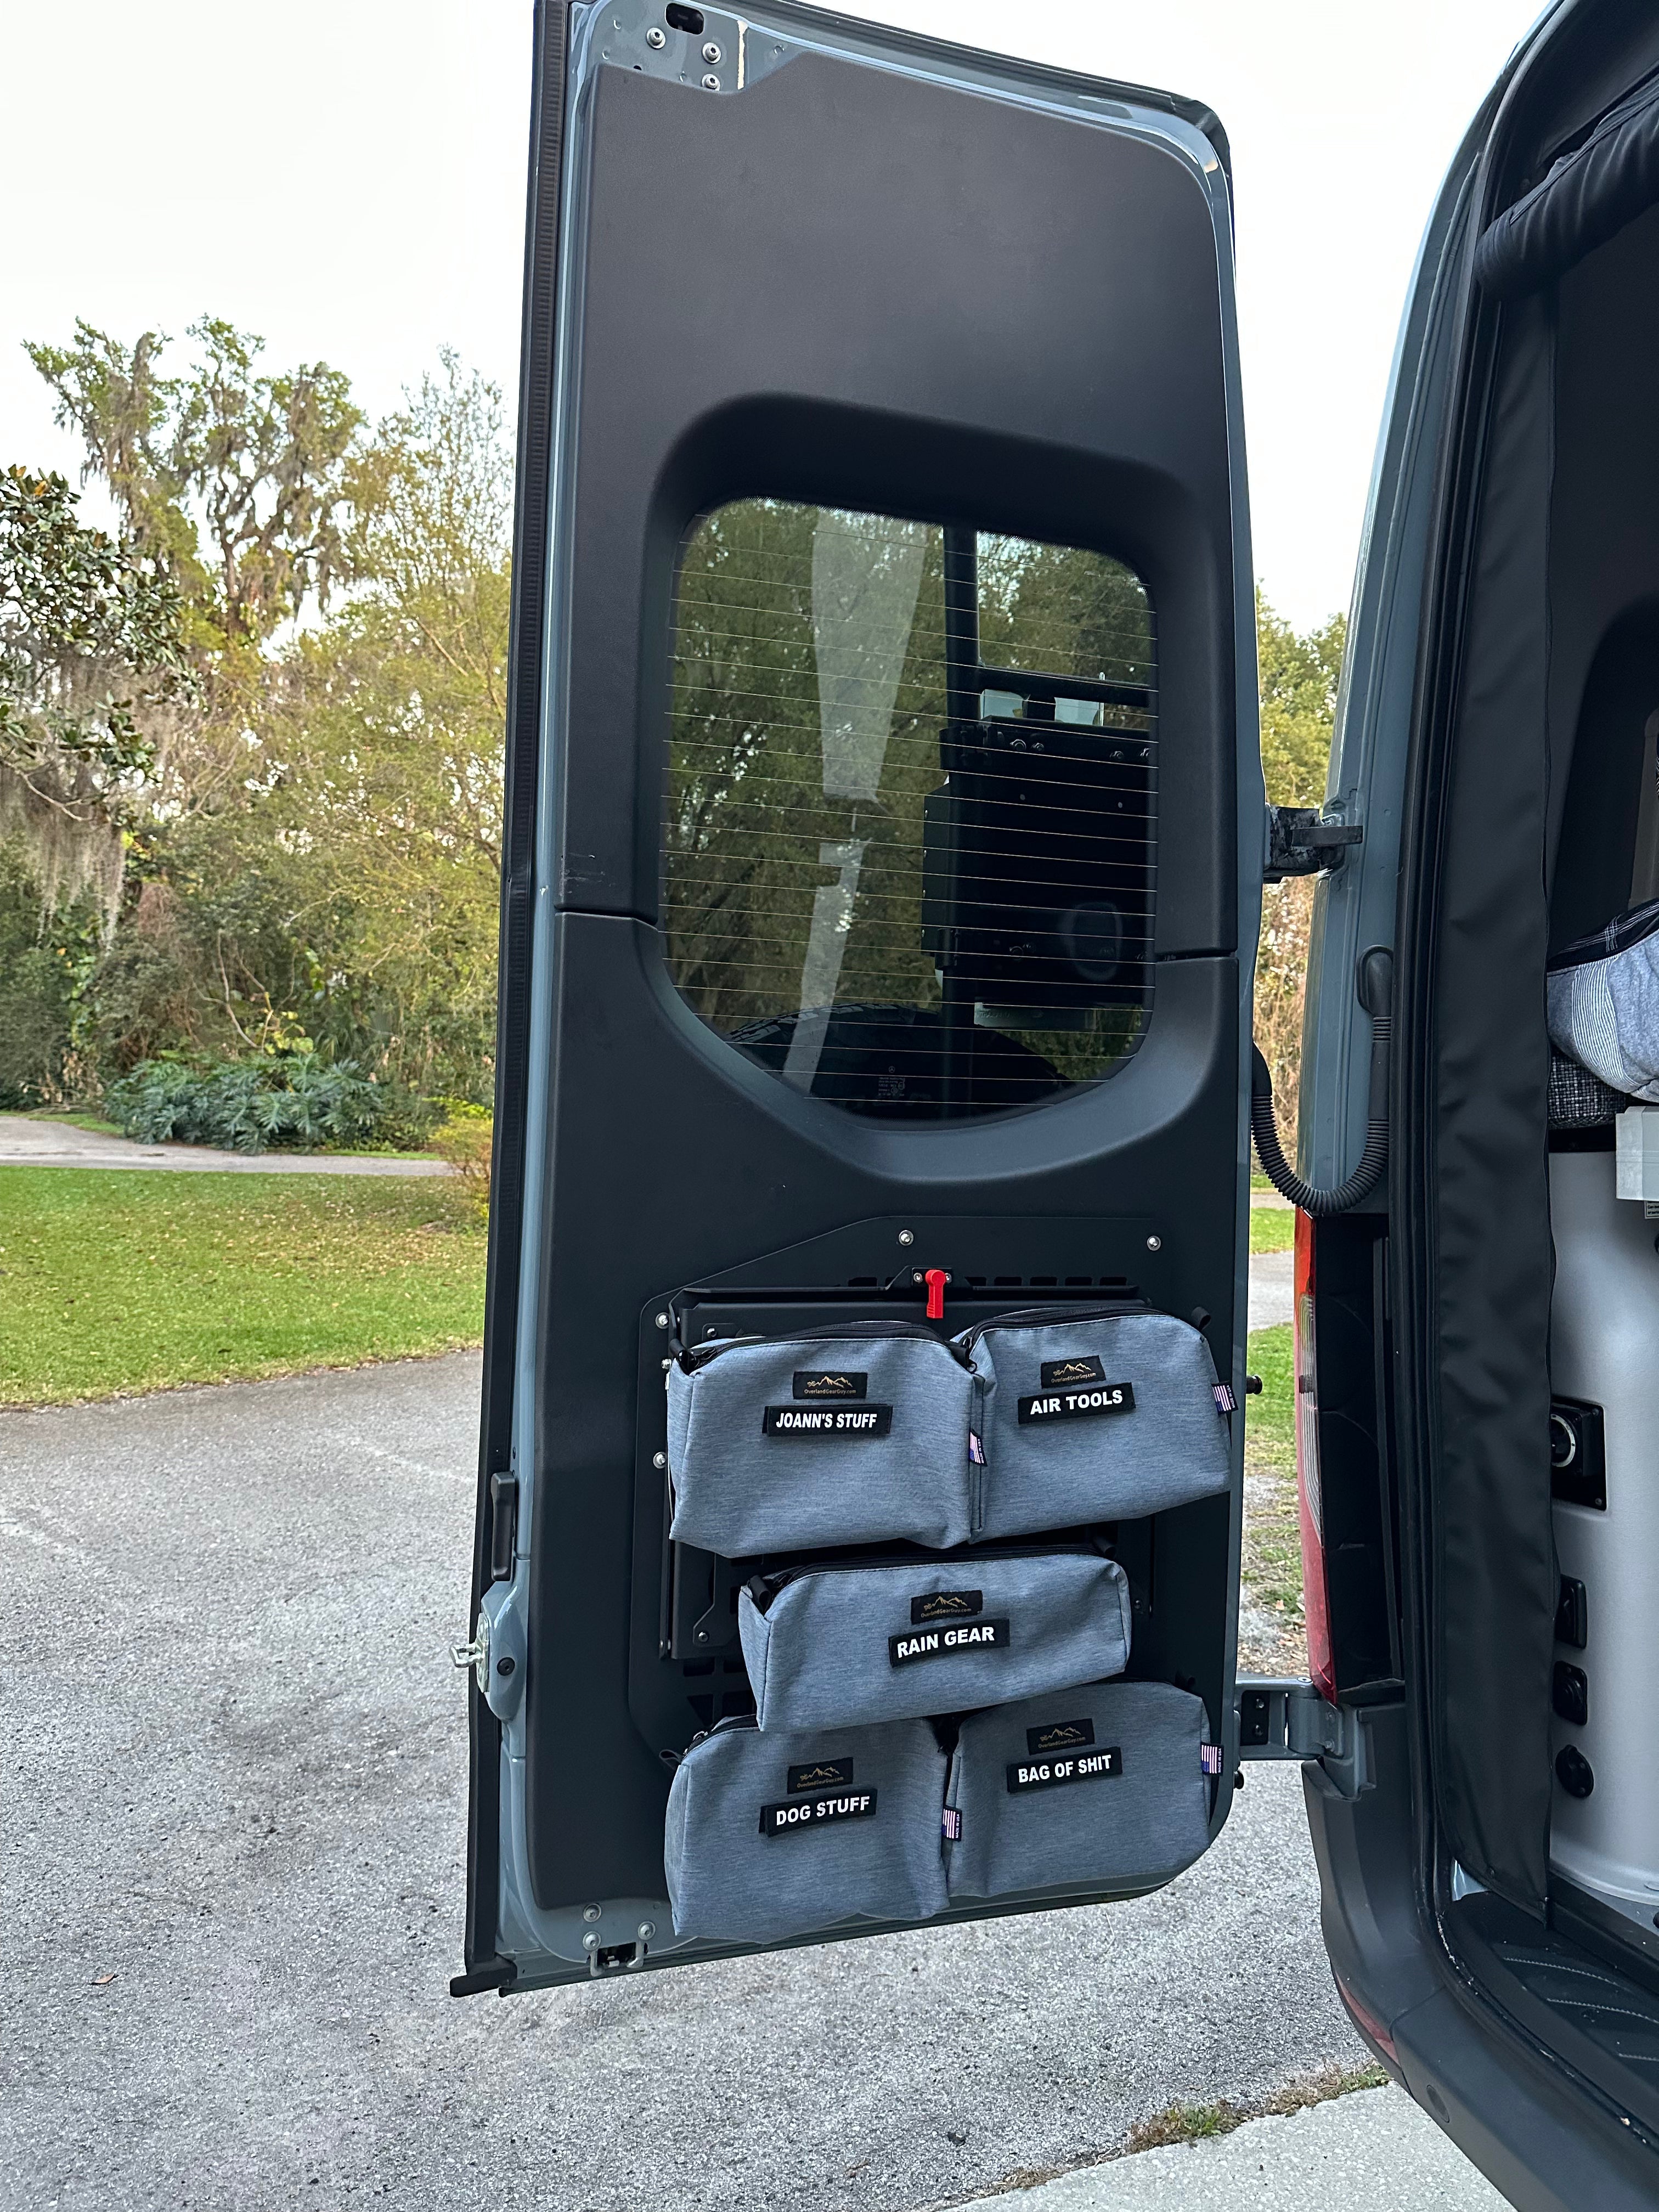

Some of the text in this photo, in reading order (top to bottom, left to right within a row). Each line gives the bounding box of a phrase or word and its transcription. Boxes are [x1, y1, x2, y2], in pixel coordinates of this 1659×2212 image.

[1051, 1372, 1097, 1383] OverlandGearGuy.com
[1030, 1390, 1122, 1415] AIR TOOLS
[776, 1412, 877, 1428] JOANN'S STUFF
[921, 1607, 972, 1618] OverlandGearGuy.com
[897, 1627, 995, 1658] RAIN GEAR
[1038, 1736, 1086, 1748] OverlandGearGuy.com
[1018, 1754, 1111, 1783] BAG OF SHIT
[776, 1796, 870, 1826] DOG STUFF
